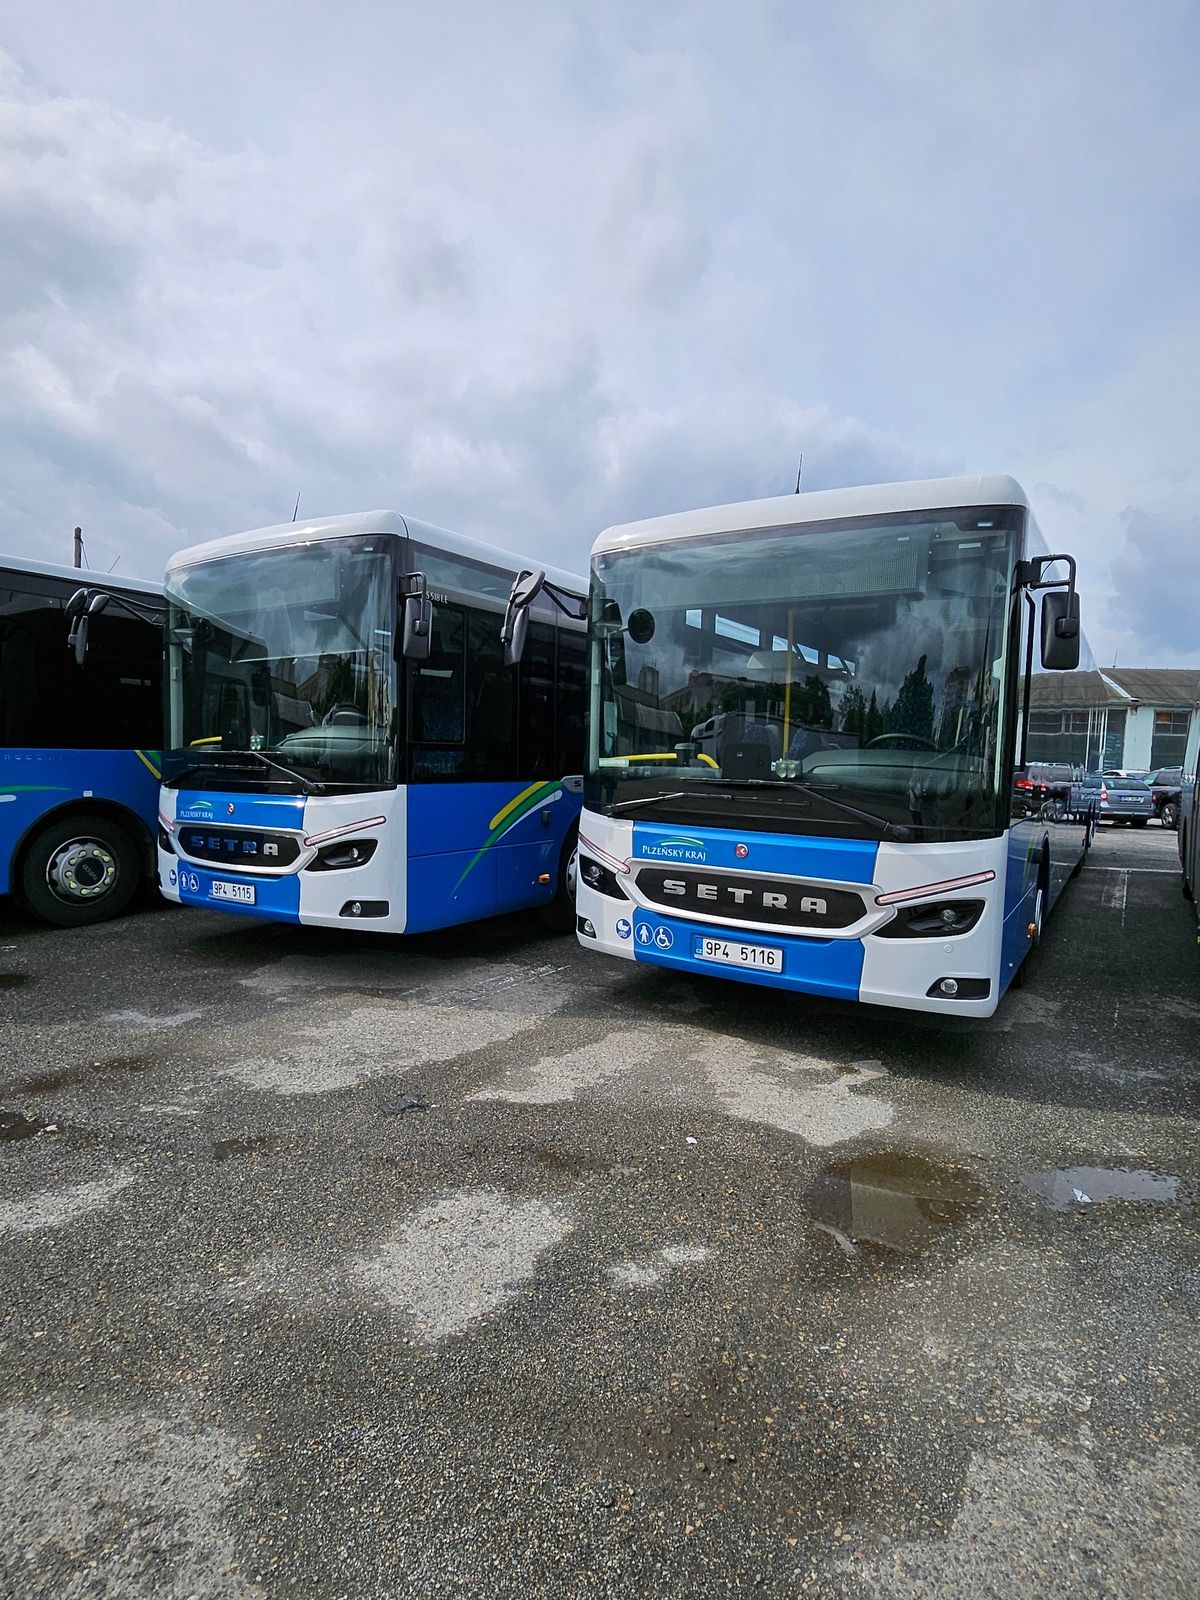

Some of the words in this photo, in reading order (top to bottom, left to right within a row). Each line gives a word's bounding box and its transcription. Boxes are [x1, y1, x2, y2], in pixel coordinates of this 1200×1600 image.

[202, 811, 214, 820] KRAJ
[191, 836, 279, 856] SETRA
[642, 845, 684, 858] PLZEŇSKÝ
[685, 850, 706, 862] KRAJ
[214, 883, 228, 896] 9P4
[232, 885, 251, 900] 5115
[663, 879, 827, 914] SETRA
[706, 941, 730, 959] 9P4
[740, 946, 775, 965] 5116
